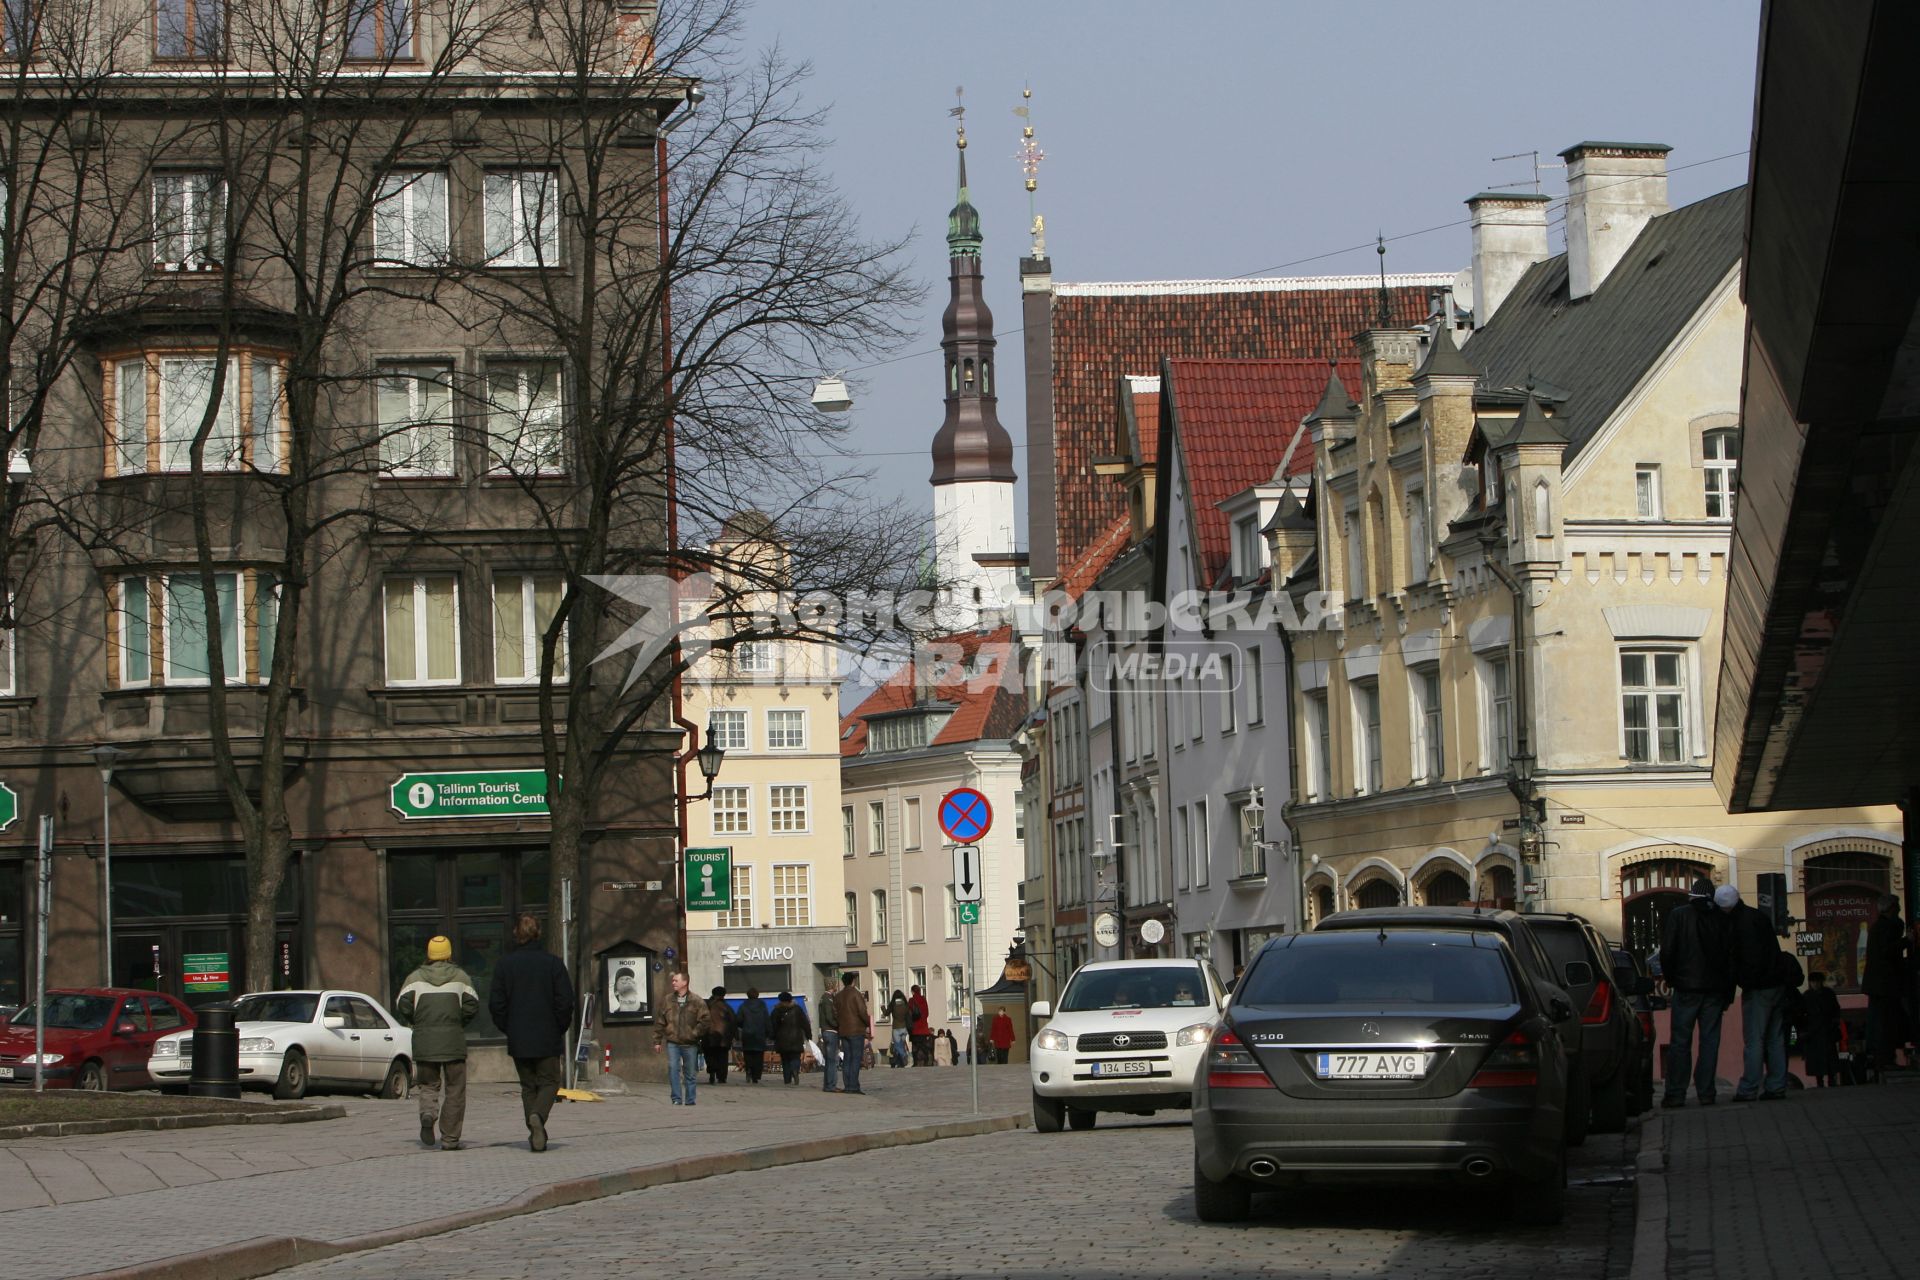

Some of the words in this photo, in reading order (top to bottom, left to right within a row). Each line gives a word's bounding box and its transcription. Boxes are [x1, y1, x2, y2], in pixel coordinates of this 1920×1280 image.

[437, 783, 475, 795] Tallinn
[478, 782, 520, 793] Tourist
[439, 795, 509, 807] Information
[512, 793, 545, 805] Centr
[688, 853, 726, 862] TOURIST
[651, 881, 657, 889] 2
[743, 946, 794, 961] SAMPO
[1103, 1063, 1119, 1073] 134
[1124, 1062, 1145, 1072] ESS
[1336, 1056, 1369, 1073] 777
[1375, 1056, 1416, 1073] AYG
[0, 1068, 12, 1076] AP
